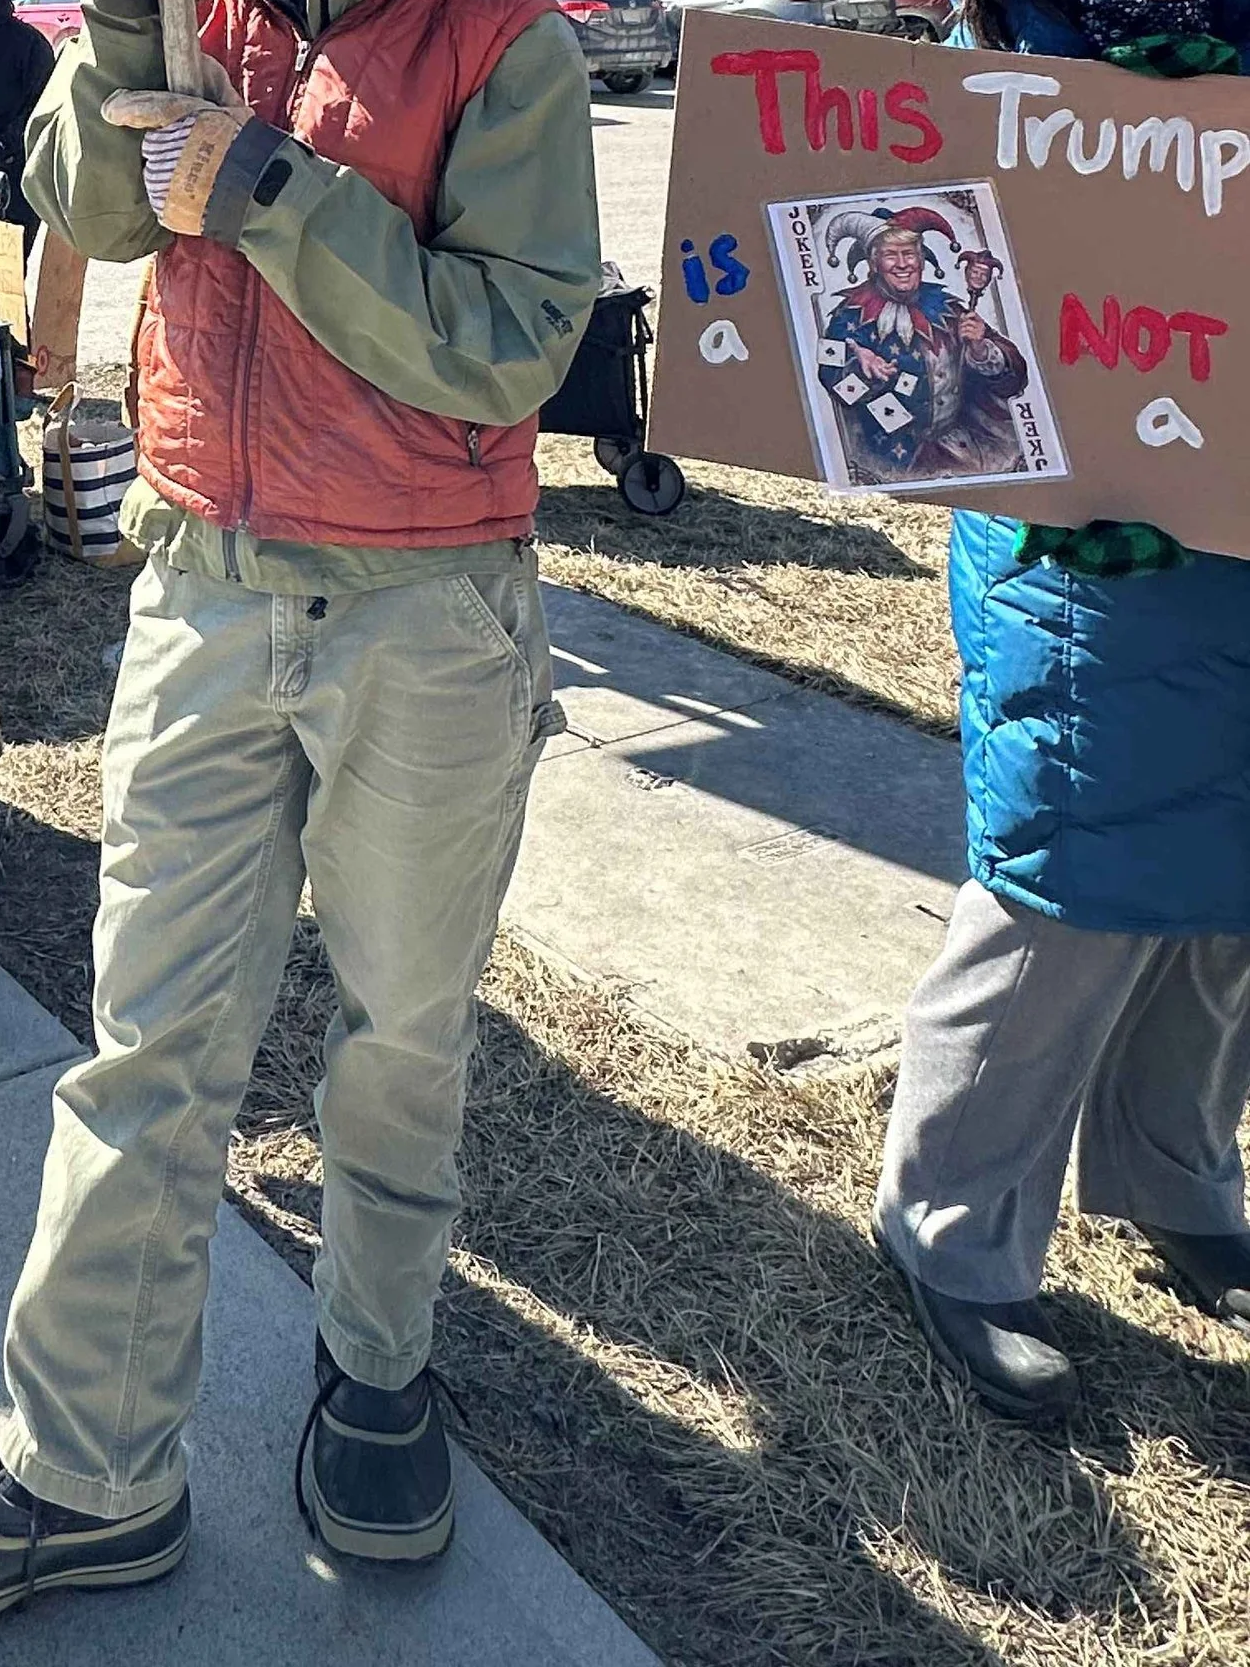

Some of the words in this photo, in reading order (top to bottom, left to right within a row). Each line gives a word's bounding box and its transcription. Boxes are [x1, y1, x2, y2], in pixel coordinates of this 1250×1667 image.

[962, 72, 1250, 217] Trump
[788, 205, 819, 288] JOKER
[698, 319, 749, 364] a
[1058, 292, 1229, 382] NOT
[1136, 397, 1204, 449] a
